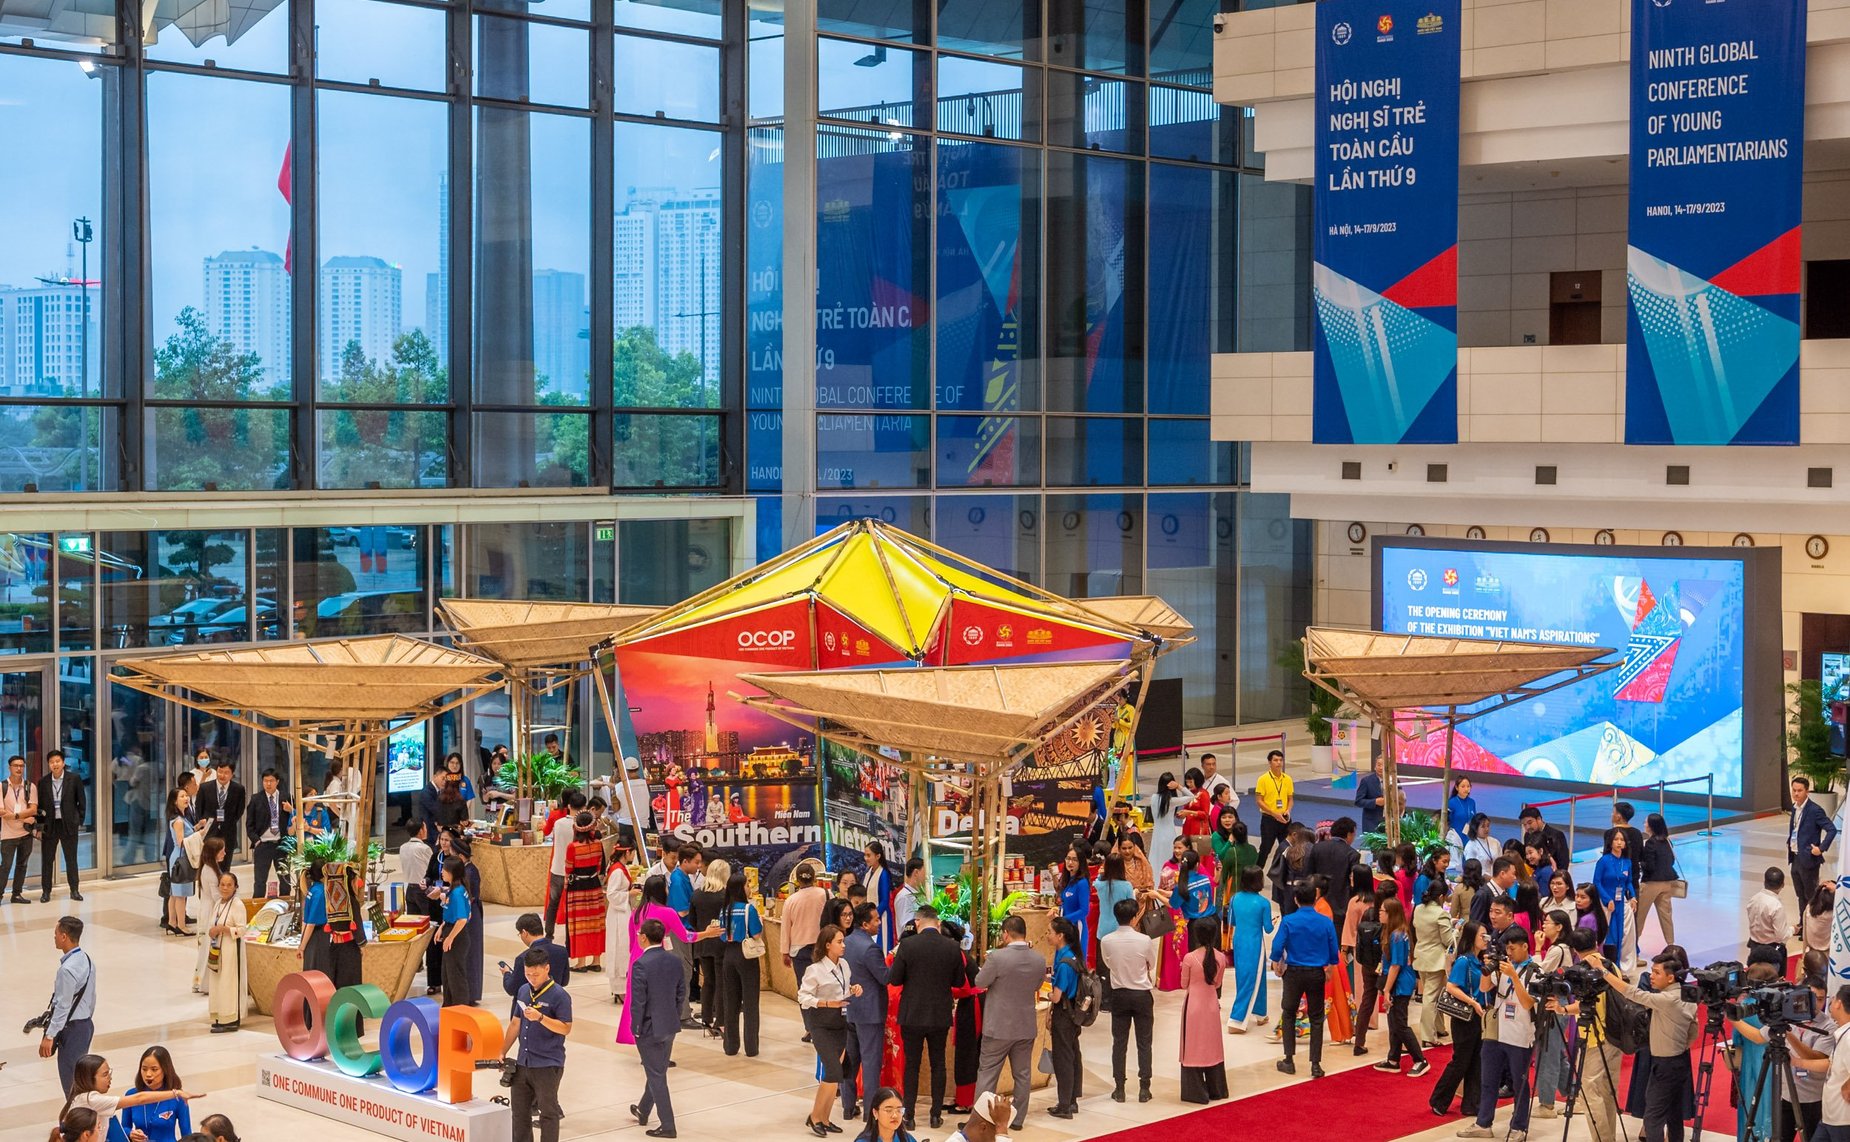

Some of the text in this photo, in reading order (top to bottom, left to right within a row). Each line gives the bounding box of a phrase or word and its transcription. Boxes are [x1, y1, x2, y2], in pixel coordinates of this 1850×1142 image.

[1649, 40, 1758, 70] NINTH GLOBAL
[1330, 78, 1401, 104] HỘI NGHỊ
[1648, 74, 1748, 102] CONFERENCE
[1330, 100, 1426, 133] NGHỊ SĨ TRẺ
[1648, 110, 1722, 134] OF YOUNG
[1330, 132, 1414, 161] TOÀN CẦU
[1648, 138, 1788, 168] PARLIAMENTARIANS
[1329, 164, 1416, 192] LẦN THỨ 9
[1646, 202, 1726, 216] HANOI, 14-17/9/2023
[1329, 222, 1397, 238] HÀ NỘI, 14-17/9/2023
[752, 266, 778, 296] HỘI
[848, 302, 894, 328] TOÀN
[824, 349, 834, 370] 9
[752, 387, 782, 404] NINT
[946, 386, 965, 404] OF
[752, 414, 782, 431] YOUN
[1408, 606, 1508, 622] THE OPENING CEREMONY
[738, 630, 796, 646] OCOP
[1408, 622, 1600, 644] OF THE EXHIBITION "VIET NAM'S ASPIRATIONS"
[670, 810, 692, 823] The
[793, 810, 810, 819] Nam
[674, 821, 821, 848] Southern
[828, 818, 896, 862] Vietnm
[272, 970, 505, 1104] OCOP
[272, 1073, 465, 1142] ONE COMMUNE ONE PRODUCT OF VIETNAM
